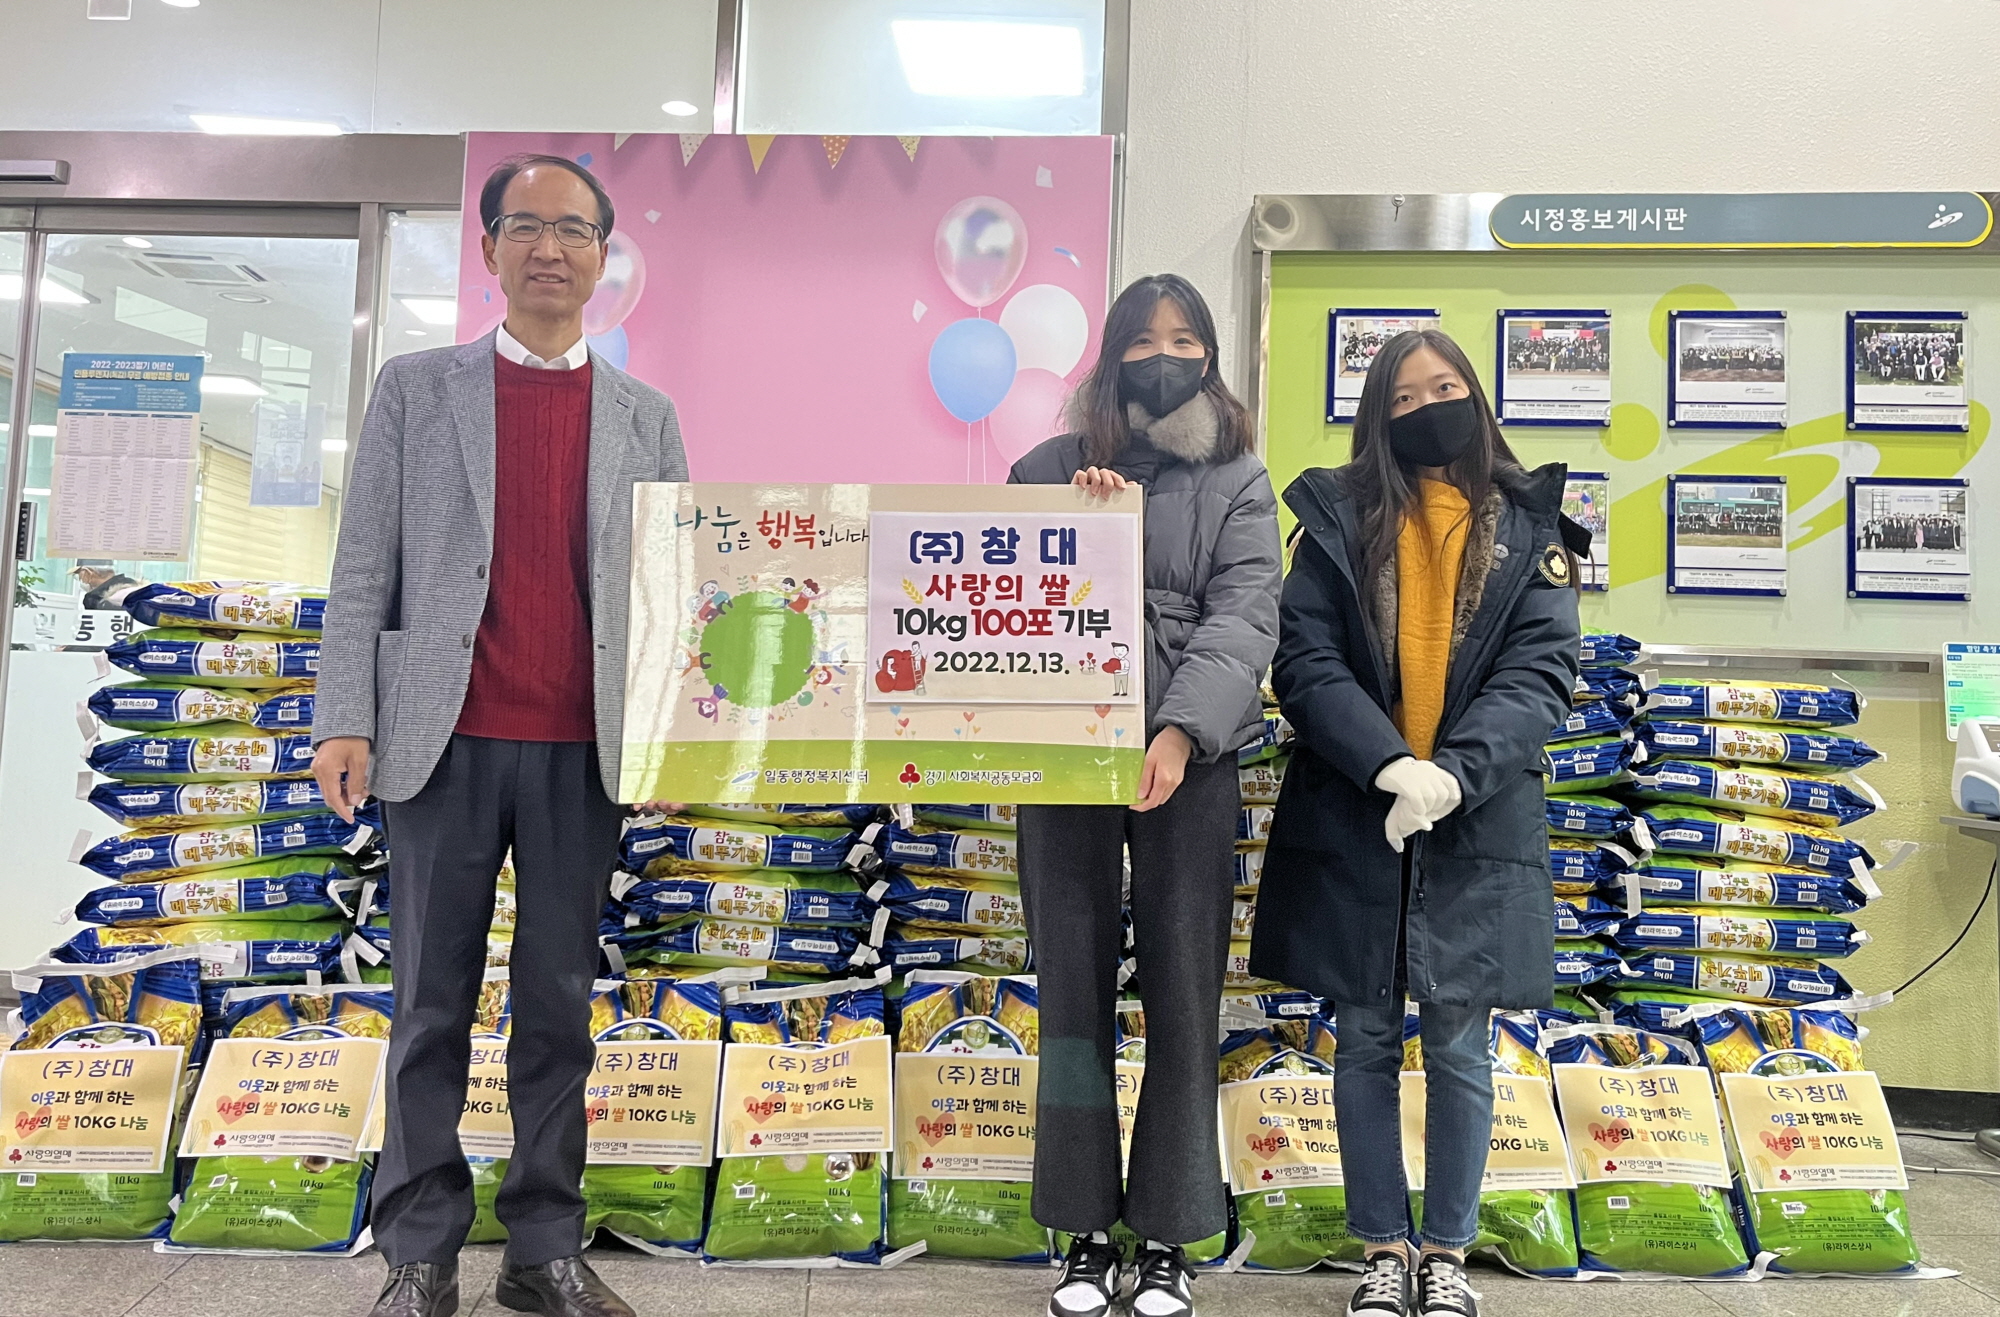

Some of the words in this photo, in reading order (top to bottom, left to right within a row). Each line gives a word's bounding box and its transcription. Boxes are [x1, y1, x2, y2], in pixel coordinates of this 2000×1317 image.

[1521, 208, 1687, 231] 시정홍보게시판
[910, 531, 964, 564] (주)
[925, 574, 1022, 606] 사랑의
[1039, 574, 1070, 605] 쌀
[894, 608, 967, 641] 10kg
[971, 609, 1053, 636] 100포
[1058, 609, 1111, 638] 기부
[934, 652, 1070, 675] 2022.12.13.
[765, 770, 868, 783] 일동행정복지센터
[925, 771, 945, 785] 경기
[950, 771, 1042, 785] 사회복지공동모금회
[238, 1079, 278, 1093] 이웃과
[283, 1079, 310, 1093] 함께
[313, 1078, 339, 1093] 하는
[588, 1084, 623, 1098] 이웃과
[627, 1083, 653, 1098] 함께
[657, 1084, 682, 1098] 하는
[761, 1080, 800, 1094] 이웃과
[803, 1081, 829, 1095] 함께
[833, 1076, 857, 1089] 하는
[31, 1092, 70, 1105] 이웃과
[74, 1091, 103, 1105] 함께
[107, 1092, 135, 1105] 하는
[218, 1101, 259, 1115] 사랑의
[263, 1102, 278, 1115] 쌀
[280, 1103, 320, 1114] 10KG
[324, 1102, 351, 1117] 나눔
[746, 1101, 786, 1115] 사랑의
[790, 1100, 804, 1114] 쌀
[807, 1099, 845, 1113] 10KG
[849, 1098, 874, 1112] 나눔
[931, 1099, 970, 1113] 이웃과
[972, 1098, 999, 1113] 함께
[1002, 1099, 1027, 1114] 하는
[1601, 1106, 1638, 1118] 이웃과
[1639, 1109, 1667, 1121] 함께
[1669, 1106, 1692, 1120] 하는
[16, 1115, 50, 1130] 사랑의
[55, 1115, 70, 1129] 쌀
[75, 1116, 116, 1129] 10KG
[120, 1116, 148, 1130] 나눔
[612, 1108, 625, 1123] 쌀
[629, 1109, 667, 1122] 10KG
[671, 1109, 696, 1125] 나눔
[1259, 1116, 1295, 1128] 이웃과
[1298, 1116, 1323, 1131] 함께
[1505, 1114, 1528, 1128] 하는
[1771, 1113, 1809, 1126] 이웃과
[1812, 1113, 1838, 1126] 함께
[1841, 1113, 1863, 1126] 하는
[919, 1123, 956, 1137] 사랑의
[960, 1123, 973, 1137] 쌀
[977, 1124, 1014, 1137] 10KG
[1593, 1129, 1634, 1142] 사랑의
[1636, 1129, 1649, 1143] 쌀
[1650, 1130, 1687, 1142] 10KG
[1689, 1132, 1709, 1146] 나눔
[1251, 1136, 1290, 1152] 사랑의
[1305, 1140, 1338, 1153] 10KG
[1525, 1138, 1549, 1152] 나눔
[1766, 1137, 1805, 1150] 사랑의
[1807, 1136, 1821, 1150] 쌀
[1823, 1137, 1857, 1149] 10KG
[1861, 1136, 1884, 1150] 나눔
[1645, 1239, 1697, 1250] (유)라이스상사
[1823, 1241, 1872, 1251] (유)라이스상사
